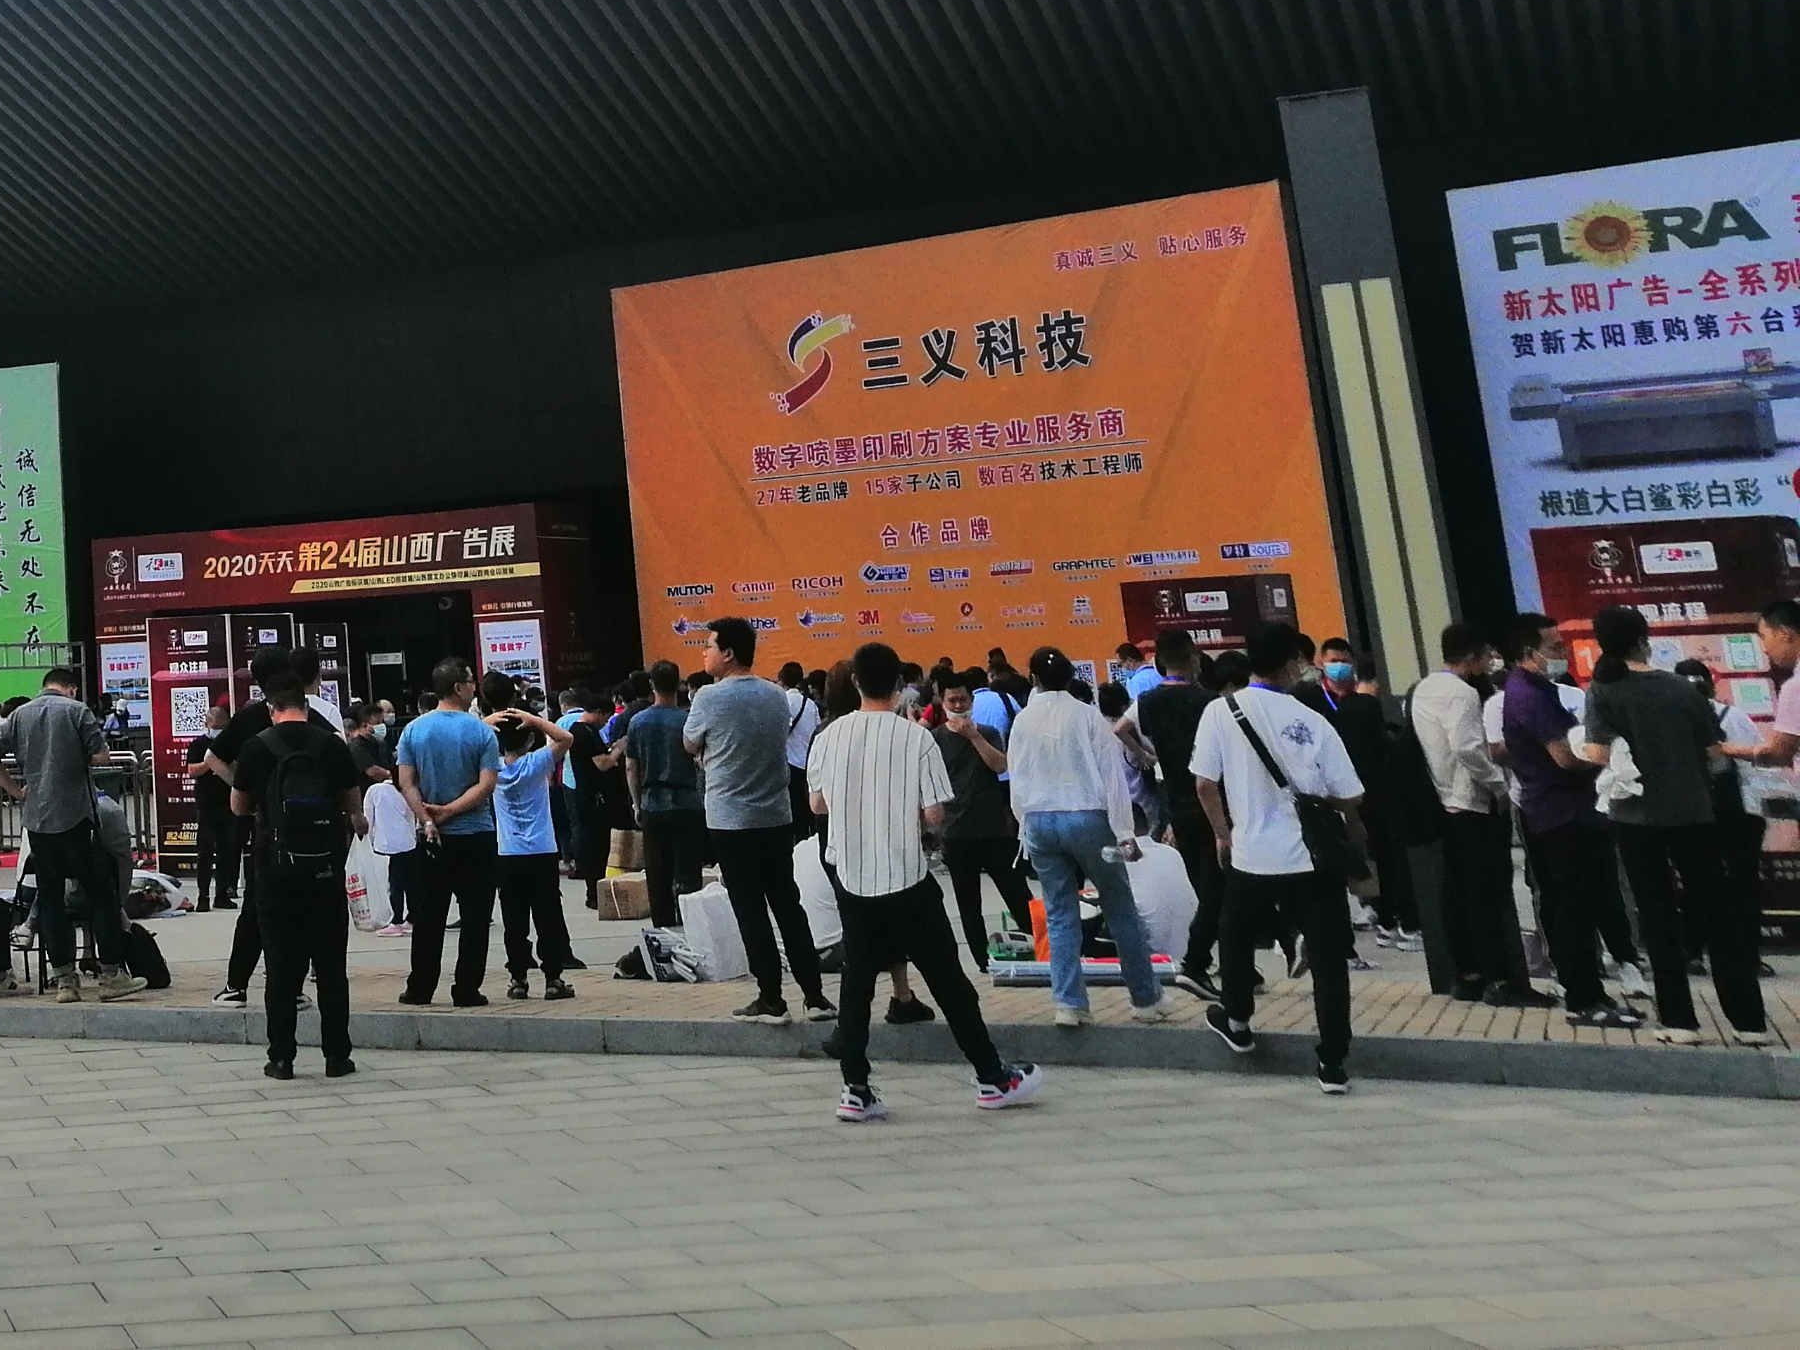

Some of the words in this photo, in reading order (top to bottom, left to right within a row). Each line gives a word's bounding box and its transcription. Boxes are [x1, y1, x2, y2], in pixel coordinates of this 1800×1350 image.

[1055, 241, 1138, 271] 真诚三义
[1158, 225, 1247, 256] 贴心服务
[1492, 199, 1771, 272] FLORA
[861, 309, 1092, 390] 三义科技
[753, 408, 1125, 474] 数字喷墨印刷方案专业服务商
[756, 479, 849, 506] 27年老品牌
[865, 469, 962, 495] 15家子公司
[977, 451, 1143, 487] 数百名技术工程师
[880, 516, 992, 548] 合作品牌
[1053, 559, 1116, 571] GRAPHTEC
[667, 585, 714, 597] MUTOH
[731, 581, 775, 594] Canon
[792, 576, 843, 590] RICOH
[858, 610, 879, 625] 3M
